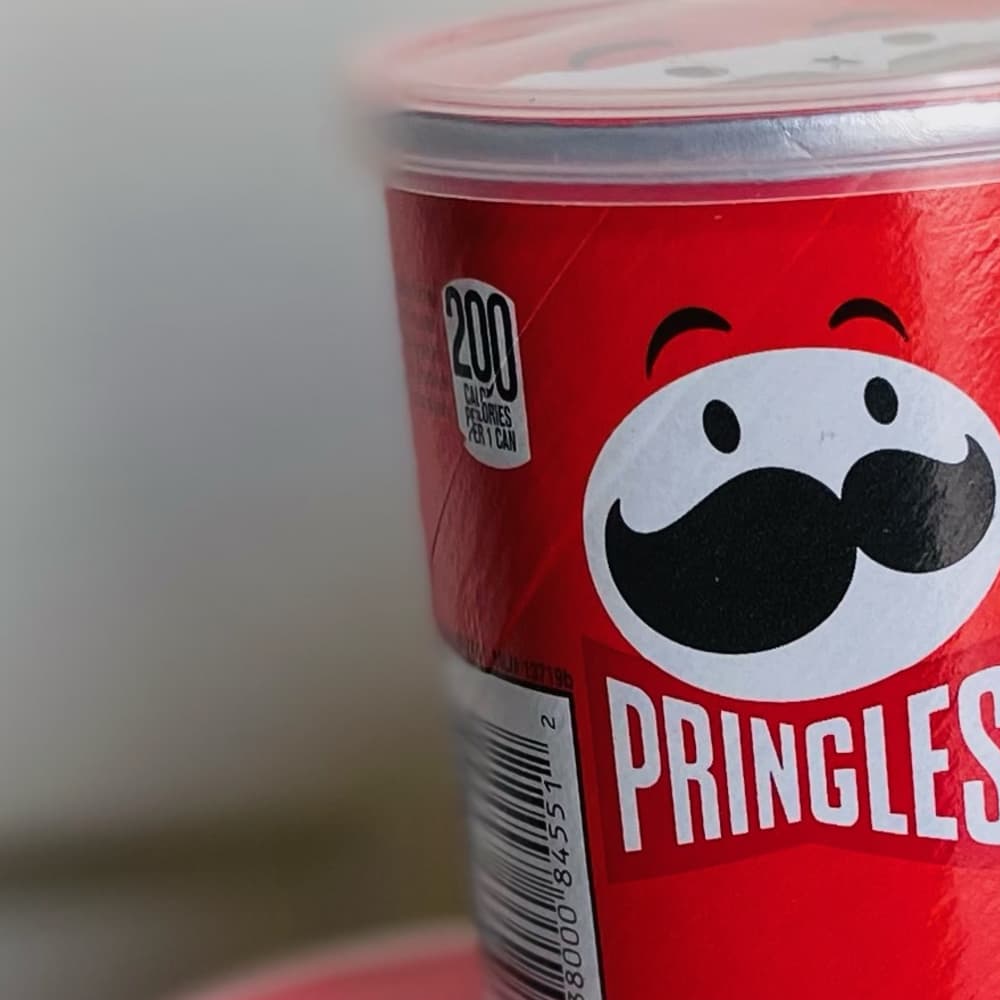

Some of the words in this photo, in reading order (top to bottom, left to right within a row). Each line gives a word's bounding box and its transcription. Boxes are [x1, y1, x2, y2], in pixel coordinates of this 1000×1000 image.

[445, 285, 518, 403] 200
[495, 427, 517, 452] CAN
[543, 780, 573, 888] 84551
